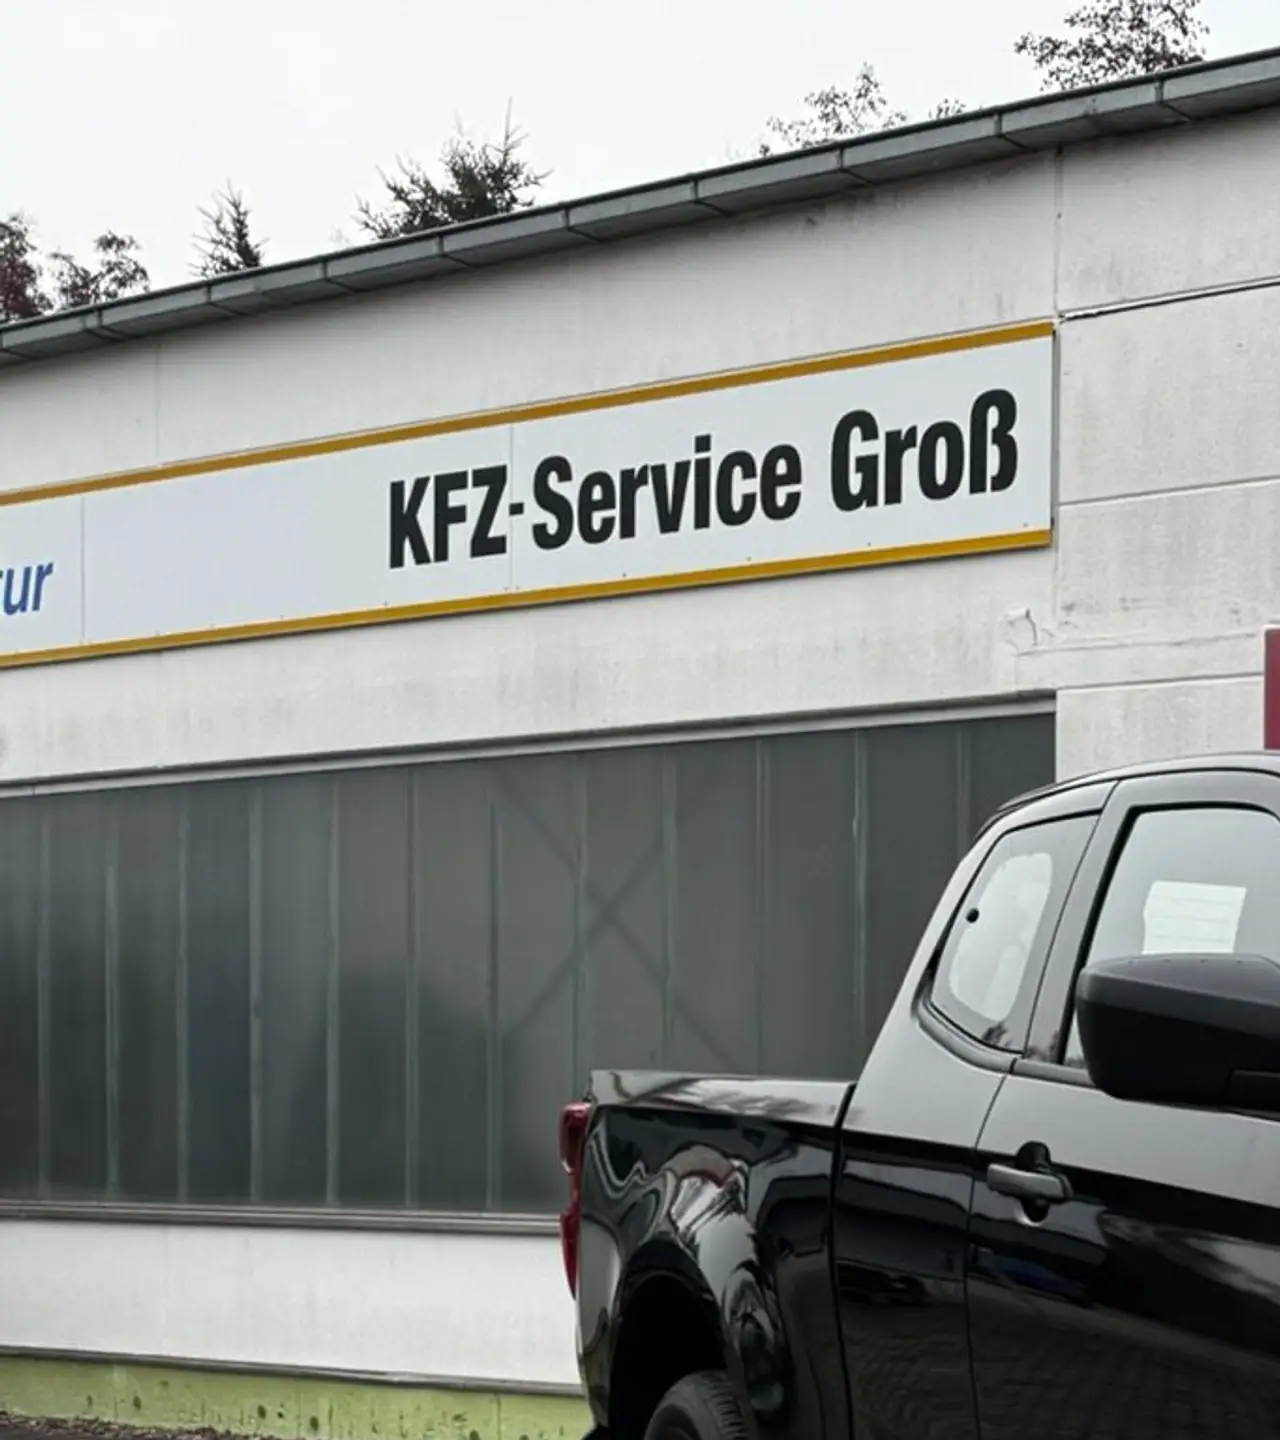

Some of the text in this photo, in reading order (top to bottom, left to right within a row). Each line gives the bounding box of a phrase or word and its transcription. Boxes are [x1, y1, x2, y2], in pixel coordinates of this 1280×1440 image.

[388, 388, 1019, 569] KFZ-Service Groß
[0, 561, 54, 616] ur
